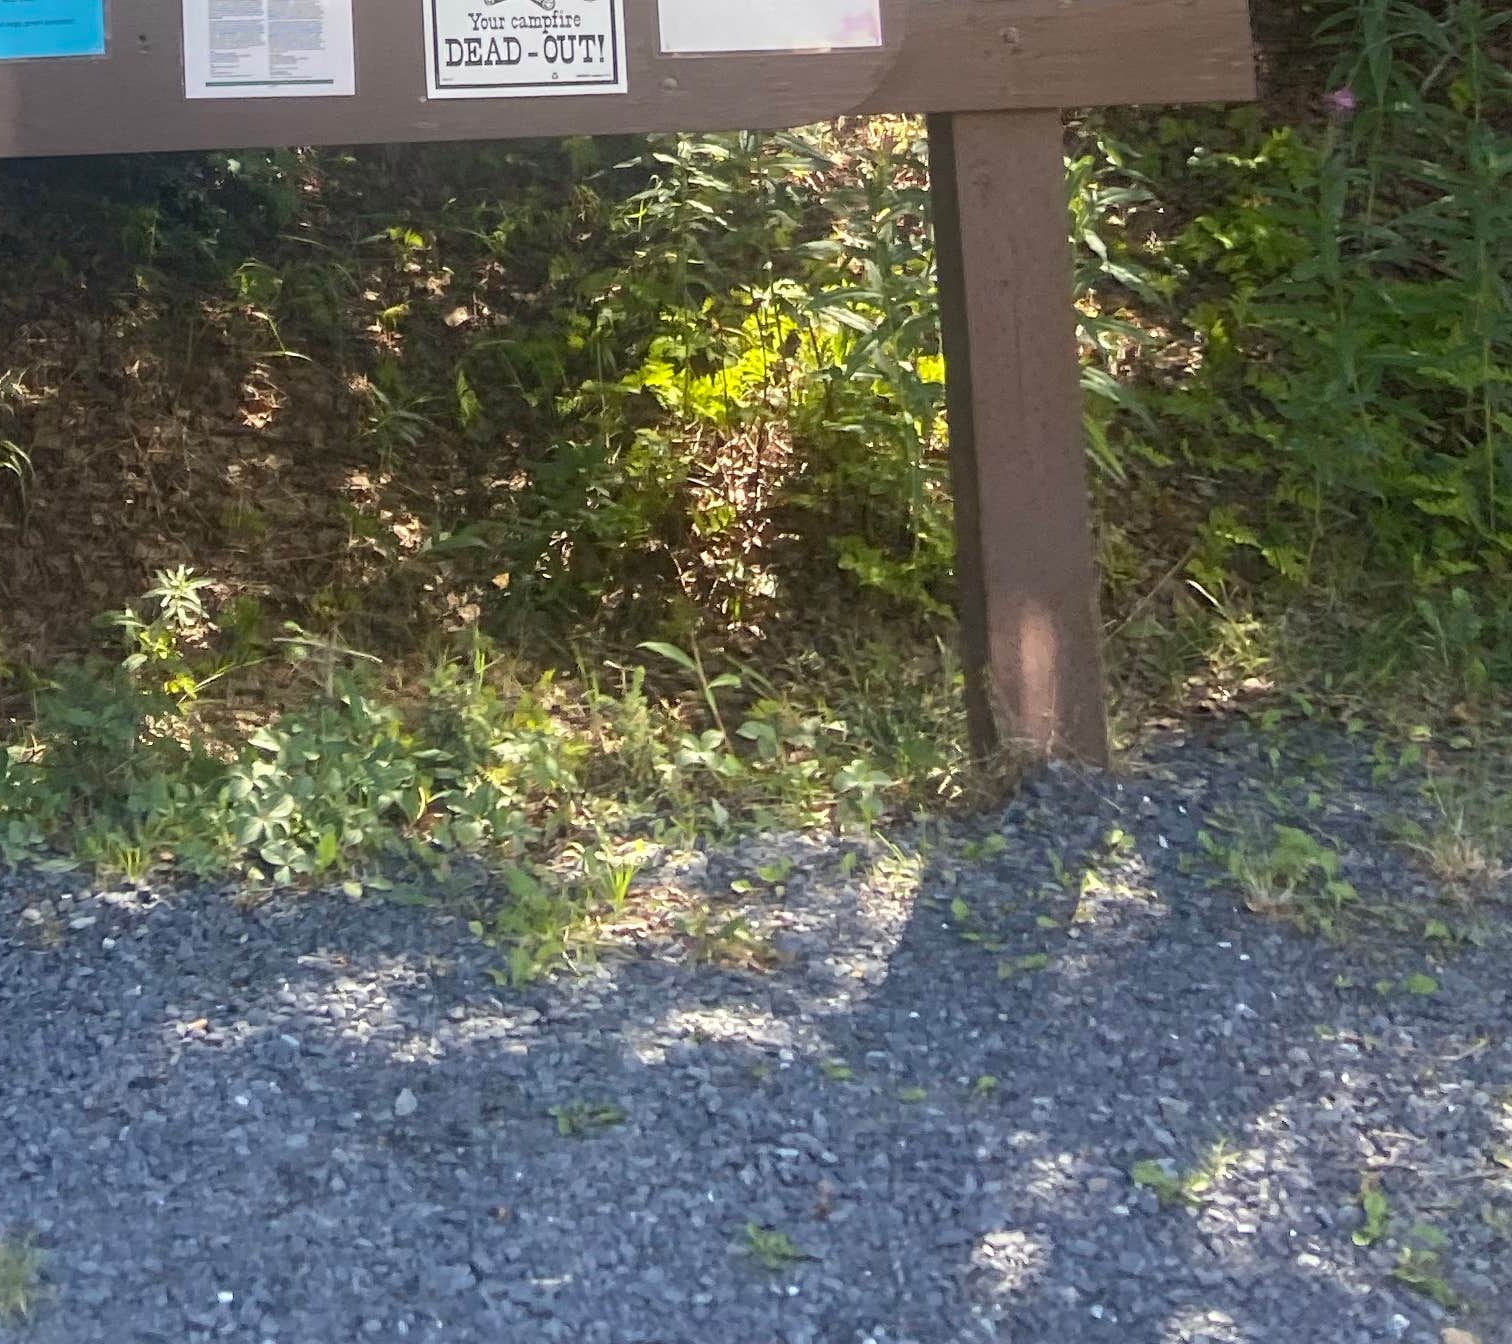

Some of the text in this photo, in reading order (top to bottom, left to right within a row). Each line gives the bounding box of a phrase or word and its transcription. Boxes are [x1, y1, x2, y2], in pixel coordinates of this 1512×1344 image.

[467, 9, 582, 35] Your campfire
[444, 36, 523, 67] DEAD
[543, 33, 605, 64] OUT!
